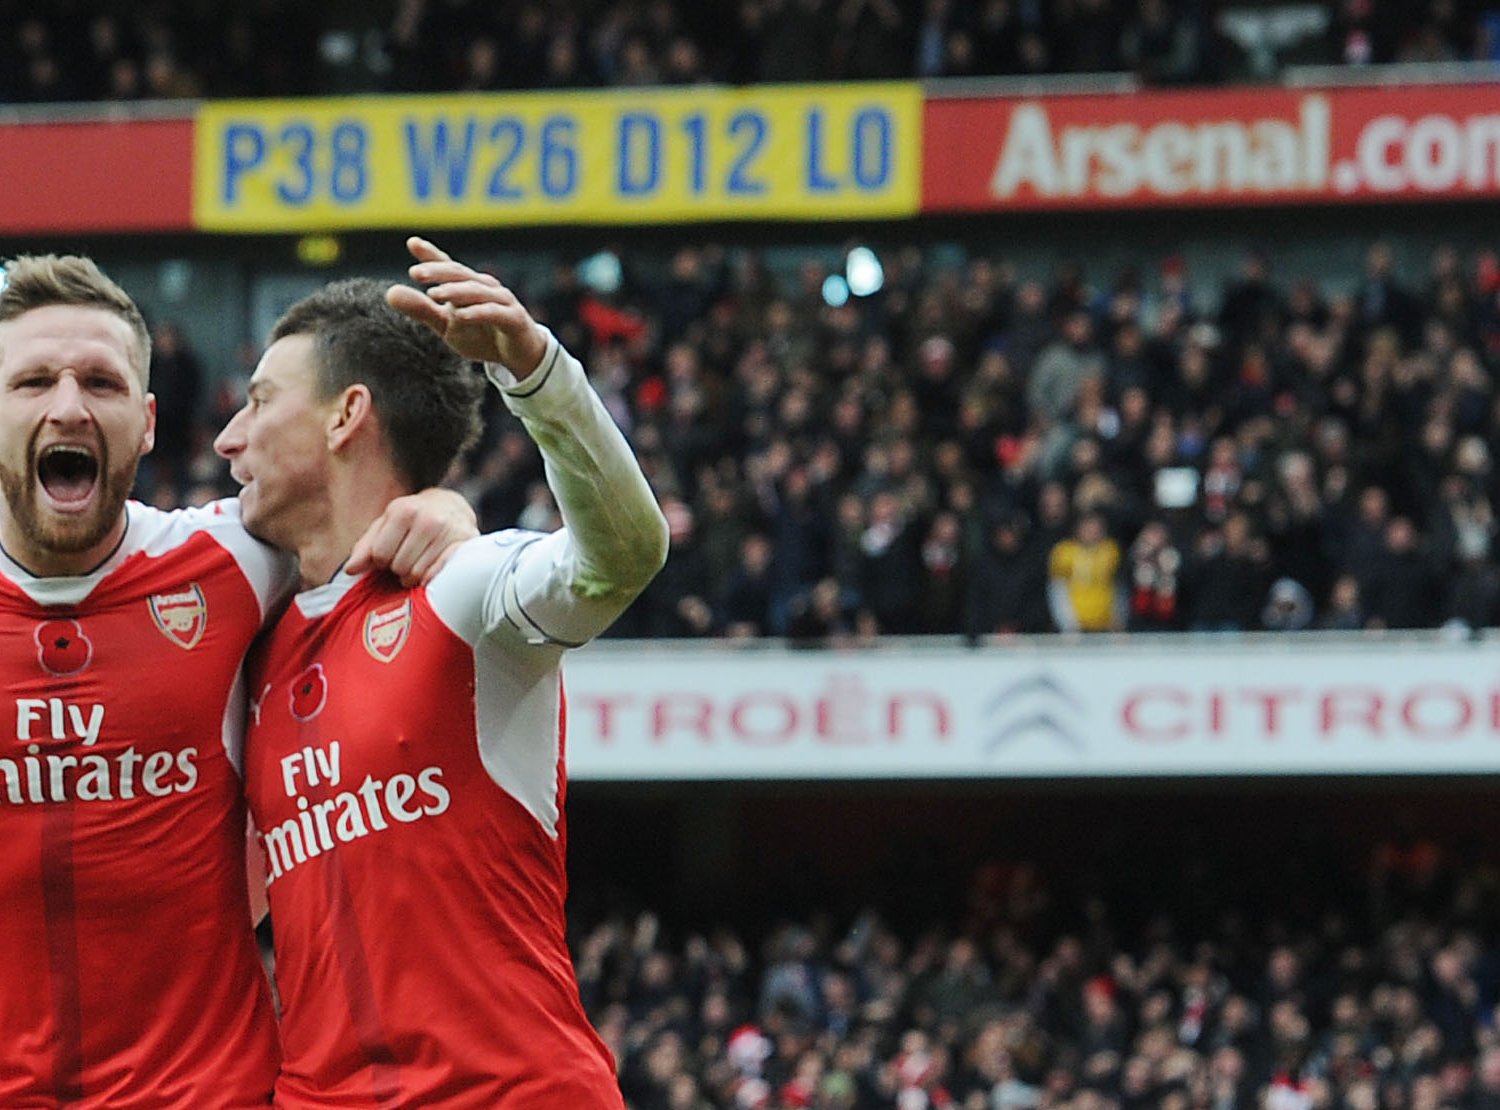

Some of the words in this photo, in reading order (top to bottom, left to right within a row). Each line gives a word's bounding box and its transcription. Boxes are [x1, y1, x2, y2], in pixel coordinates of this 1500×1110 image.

[221, 120, 369, 208] P38
[404, 114, 580, 202] W26
[616, 110, 771, 196] D12
[15, 697, 105, 745] Fly
[281, 740, 341, 798] Fly
[263, 766, 450, 889] mirates
